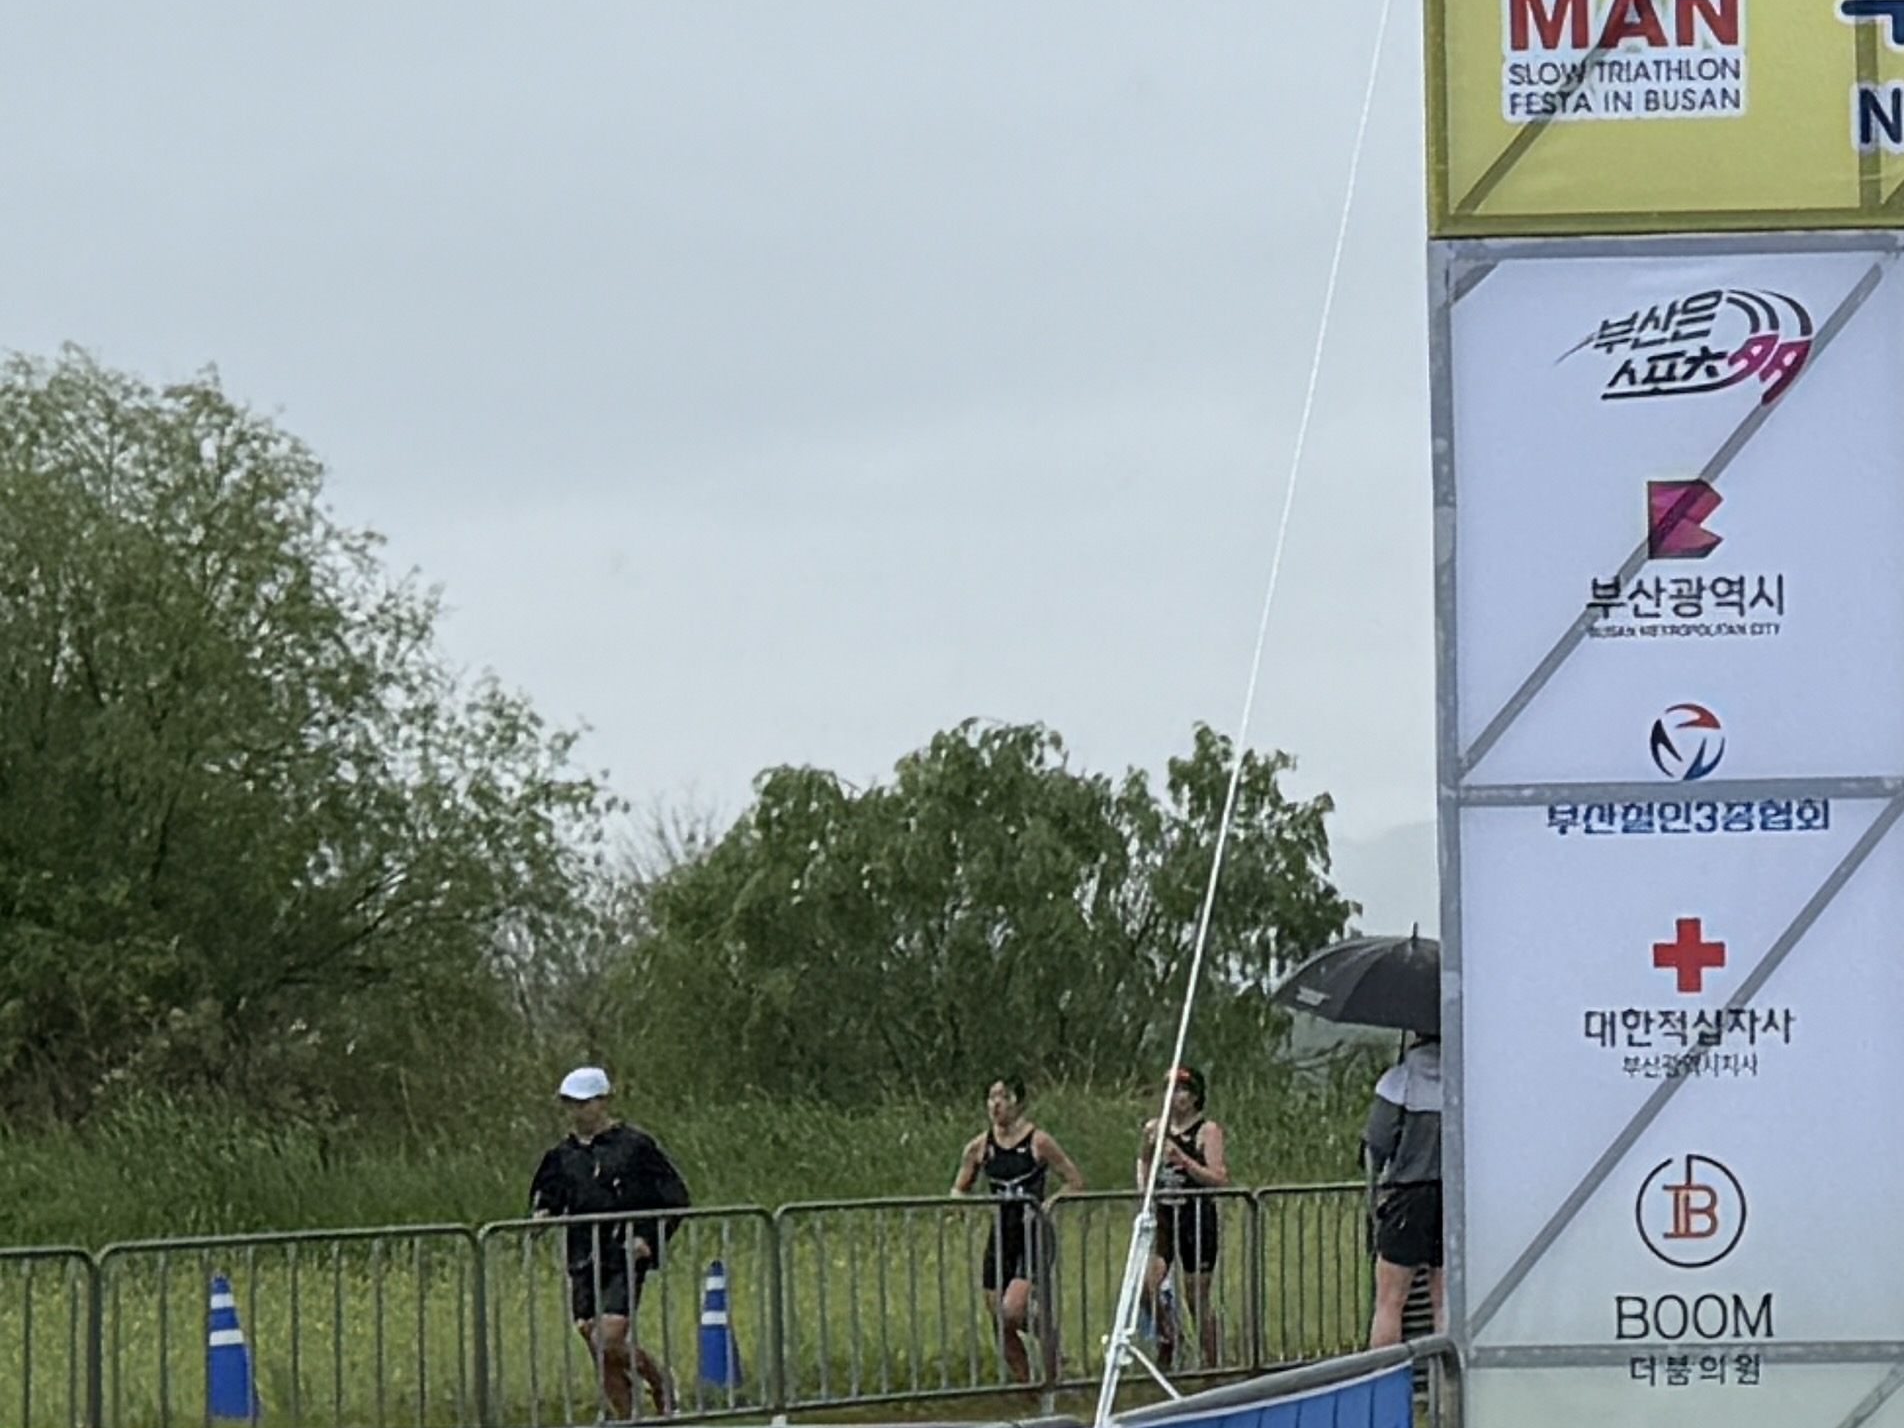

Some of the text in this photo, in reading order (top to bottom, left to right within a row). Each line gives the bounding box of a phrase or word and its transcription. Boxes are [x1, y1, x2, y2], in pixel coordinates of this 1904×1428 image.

[1509, 59, 1740, 85] SLOW TRIATHLON
[1510, 88, 1740, 115] FESTA IN BUSAN
[1586, 573, 1786, 619] 부산광역시
[1584, 1008, 1795, 1047] 대한적십자사
[1615, 1294, 1773, 1339] BOOM
